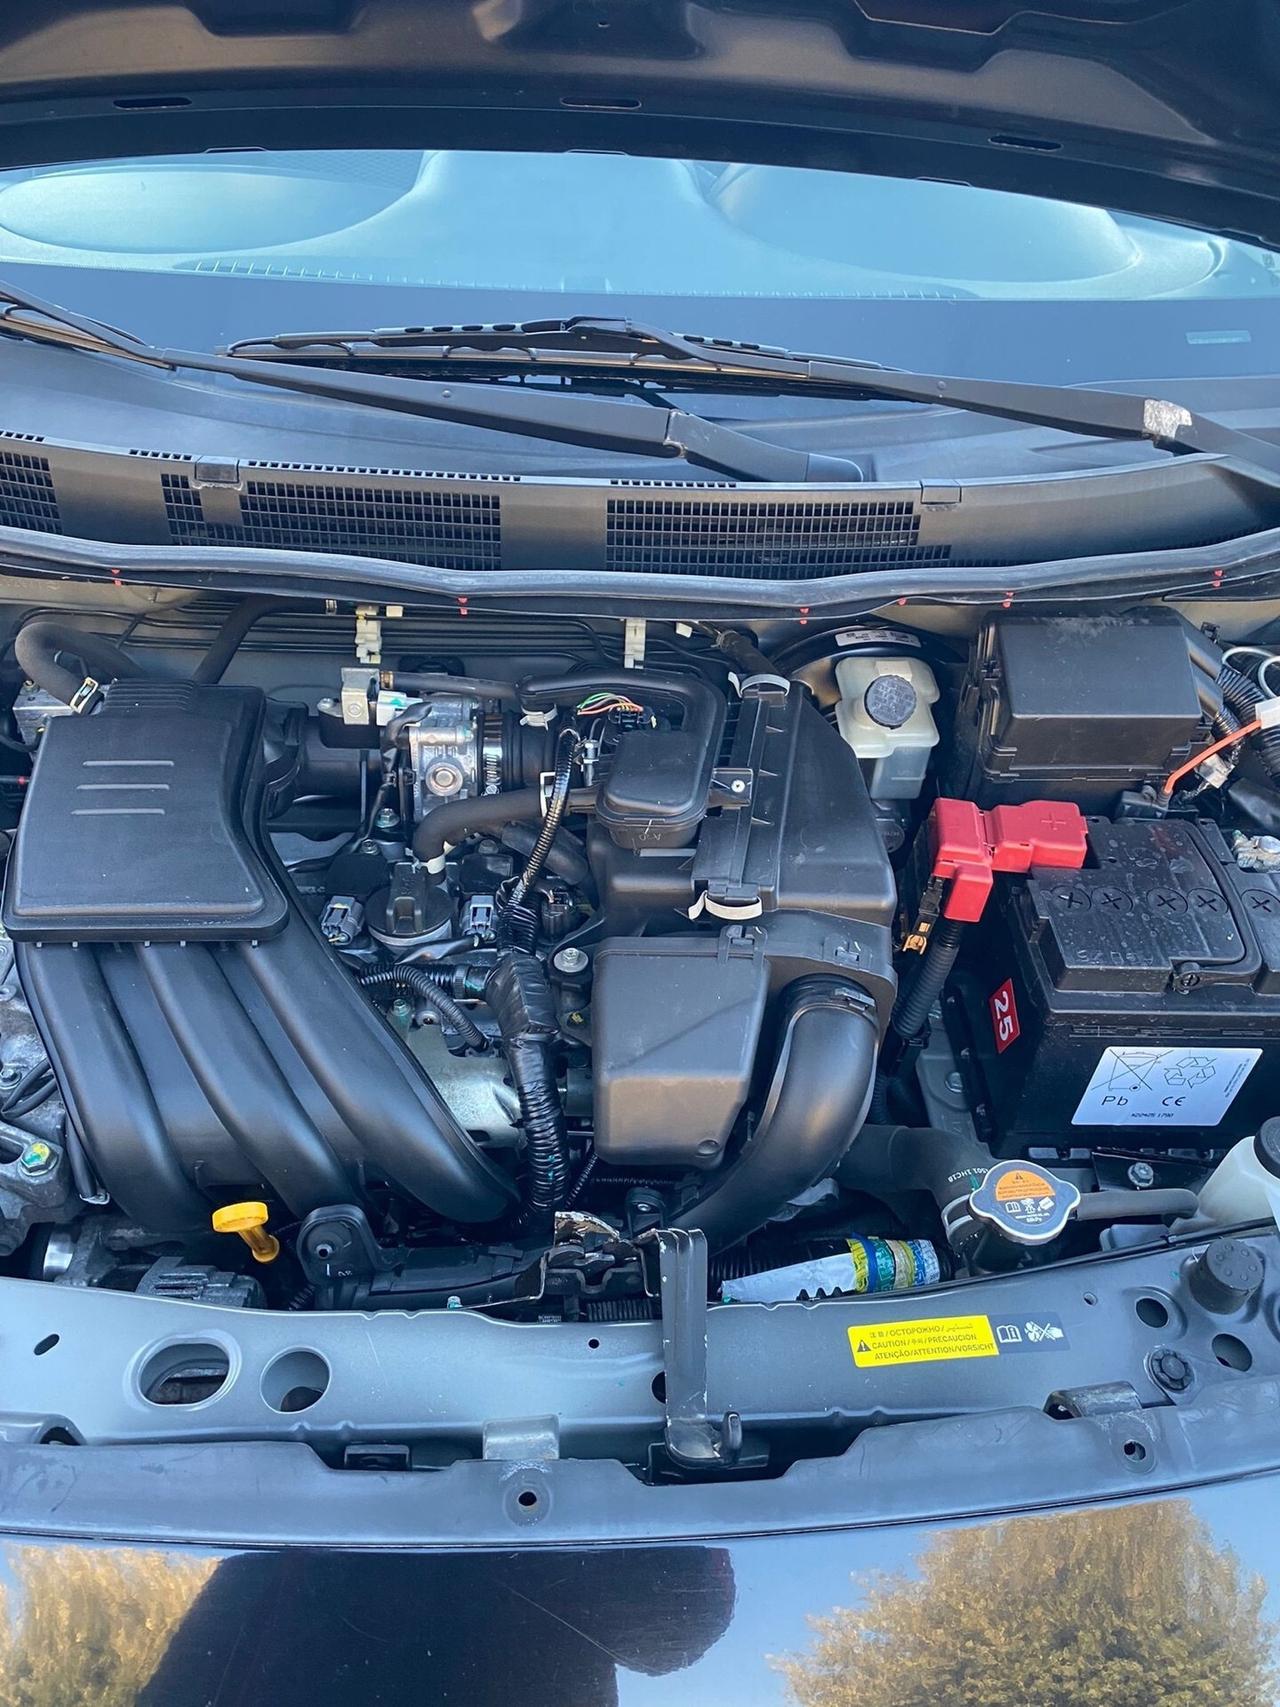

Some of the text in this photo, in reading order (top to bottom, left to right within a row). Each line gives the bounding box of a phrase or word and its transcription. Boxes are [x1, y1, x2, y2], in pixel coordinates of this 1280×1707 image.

[993, 990, 1014, 1041] 25
[1101, 1095, 1187, 1107] Pb CE
